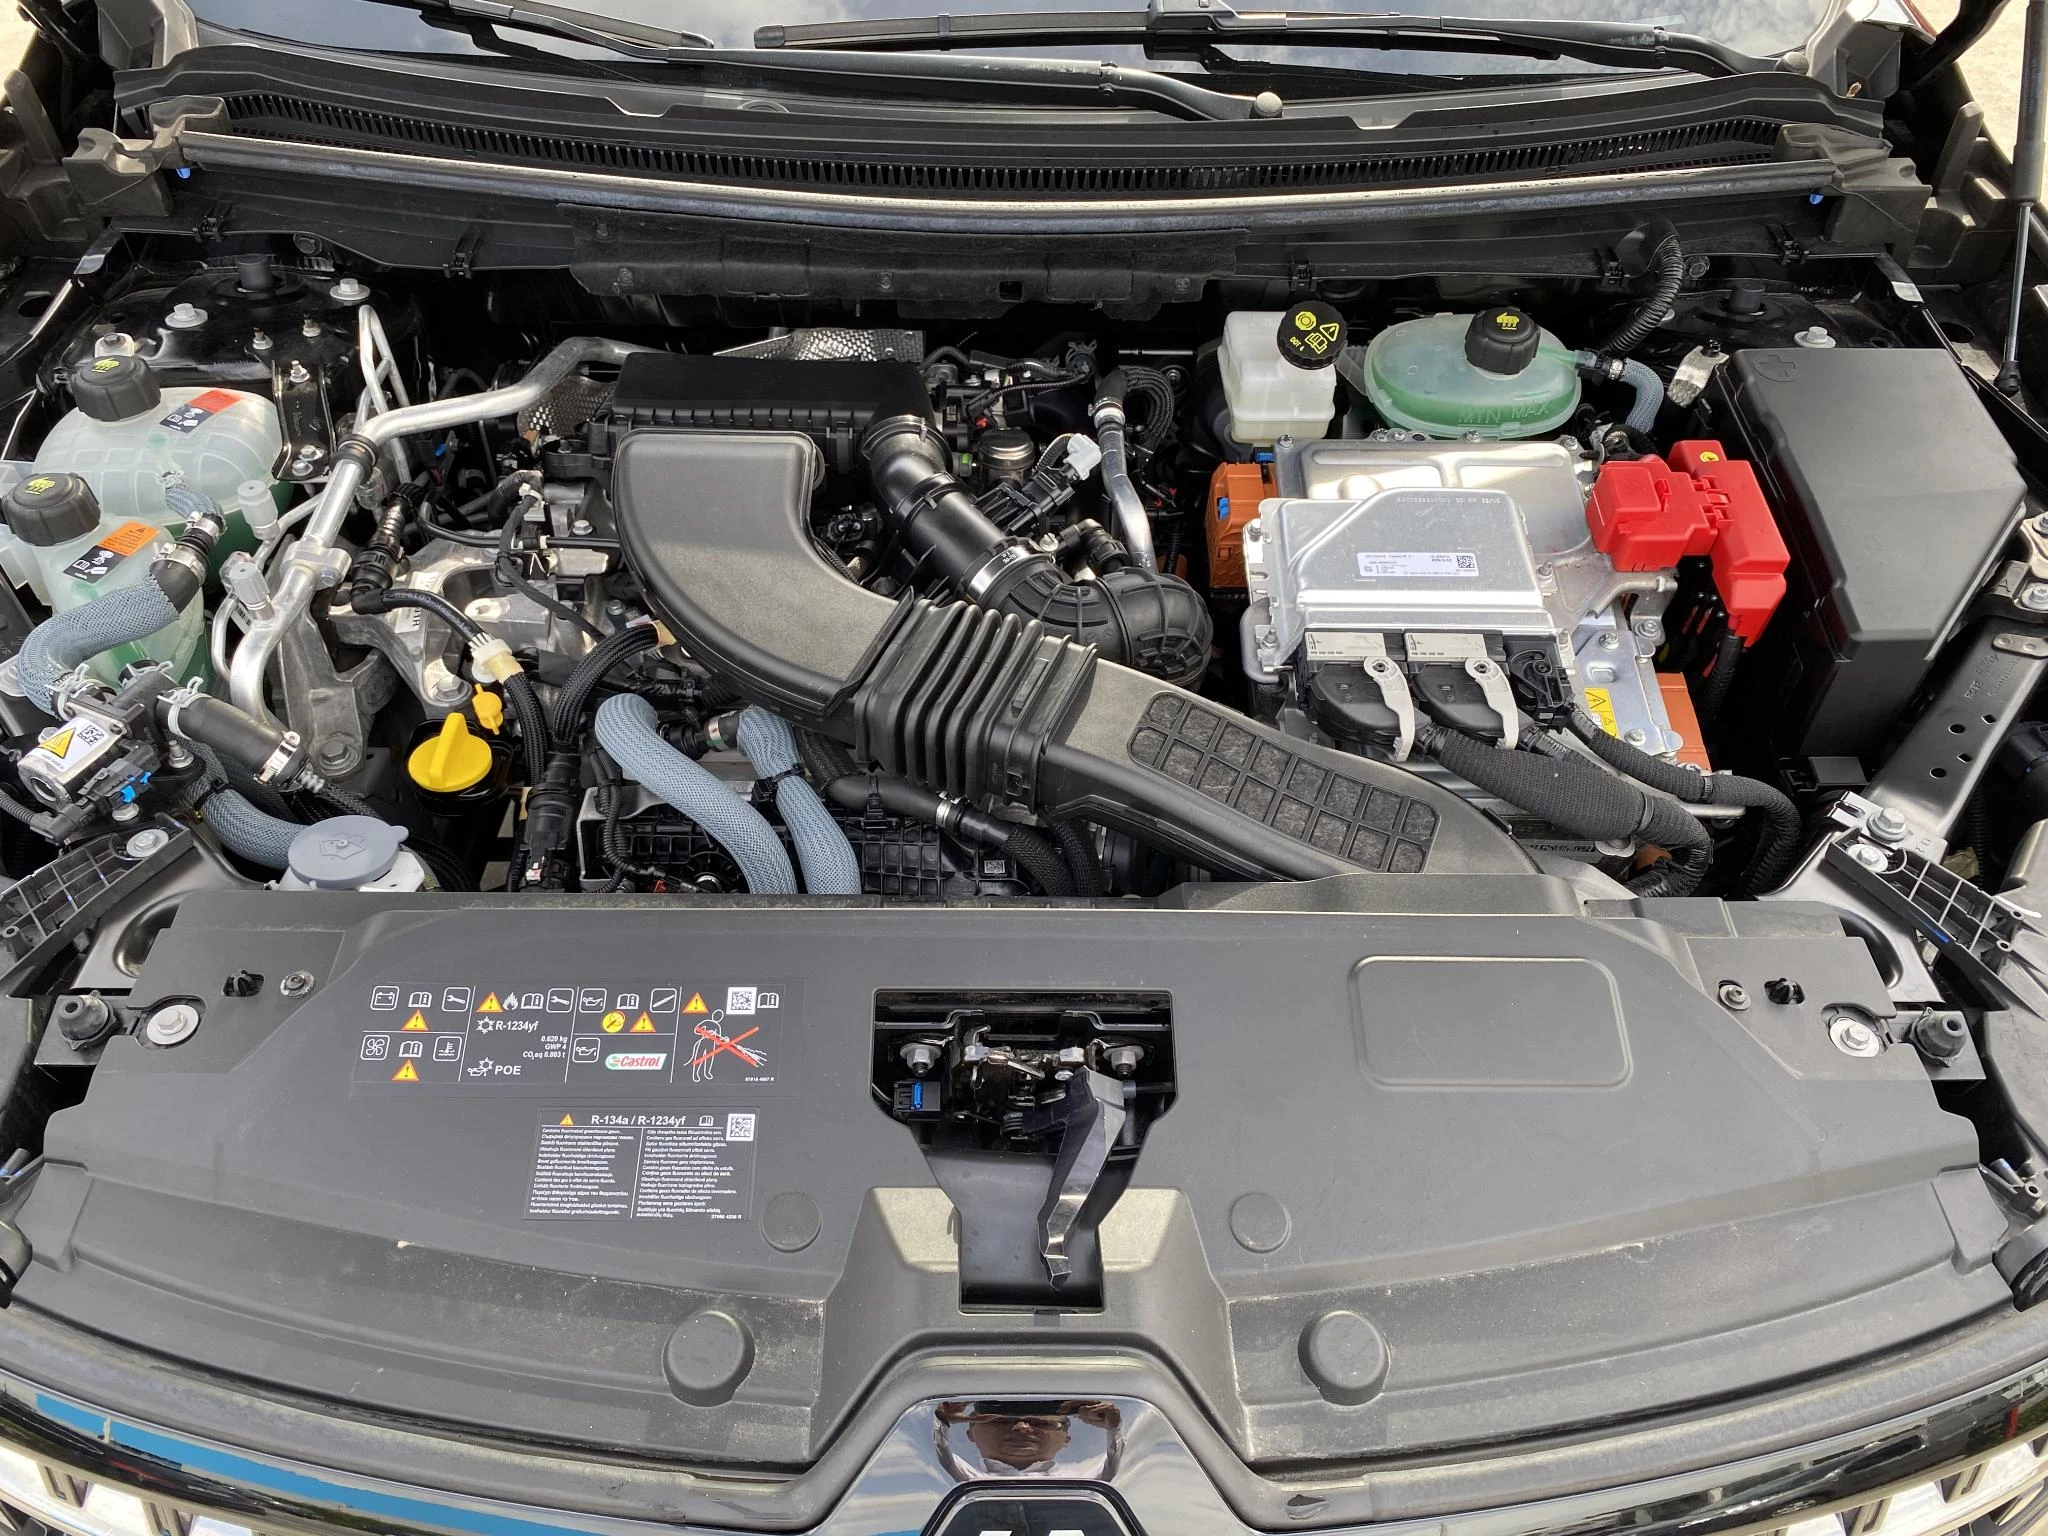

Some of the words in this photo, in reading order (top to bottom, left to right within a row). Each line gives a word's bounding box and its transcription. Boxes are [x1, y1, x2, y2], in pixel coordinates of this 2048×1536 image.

[1290, 336, 1302, 348] DOT
[1457, 408, 1500, 424] MIN
[1511, 399, 1549, 419] MAX
[495, 1020, 540, 1033] R-1234yf
[559, 1035, 569, 1044] kg
[620, 1055, 661, 1067] Castrol
[494, 1065, 522, 1075] POE
[591, 1114, 629, 1125] R-134a
[630, 1115, 636, 1125] /
[637, 1115, 687, 1128] R-1234yf
